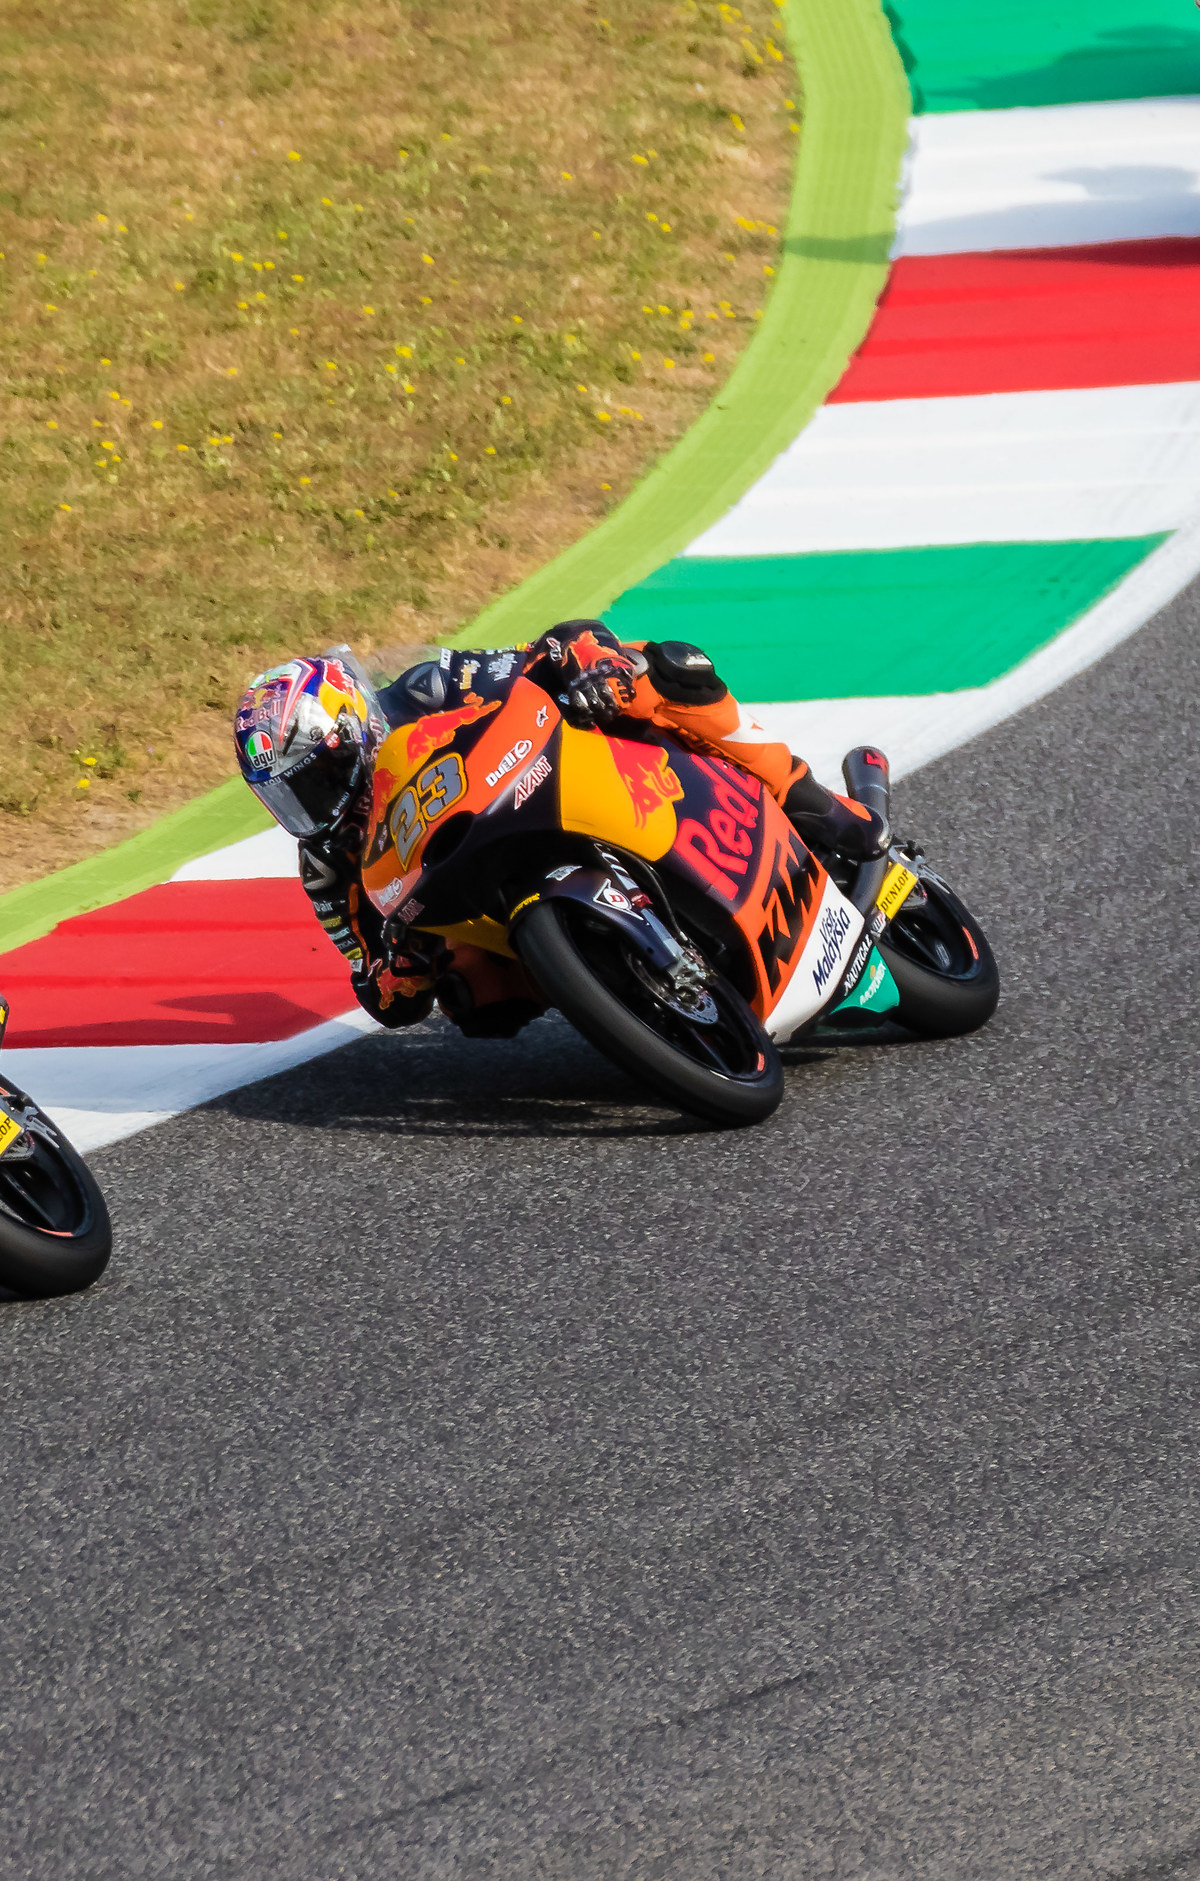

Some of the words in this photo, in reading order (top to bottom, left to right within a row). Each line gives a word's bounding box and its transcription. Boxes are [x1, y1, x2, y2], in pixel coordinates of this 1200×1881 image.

[253, 749, 274, 768] agv
[284, 752, 318, 779] WINGS
[514, 756, 553, 809] AVANT
[390, 751, 469, 872] 23
[673, 753, 762, 900] Red
[757, 829, 821, 997] KTM
[881, 870, 910, 912] DUNLOP
[812, 906, 850, 997] Malaysia
[820, 905, 838, 943] Visit
[843, 934, 873, 997] NAUTICAL
